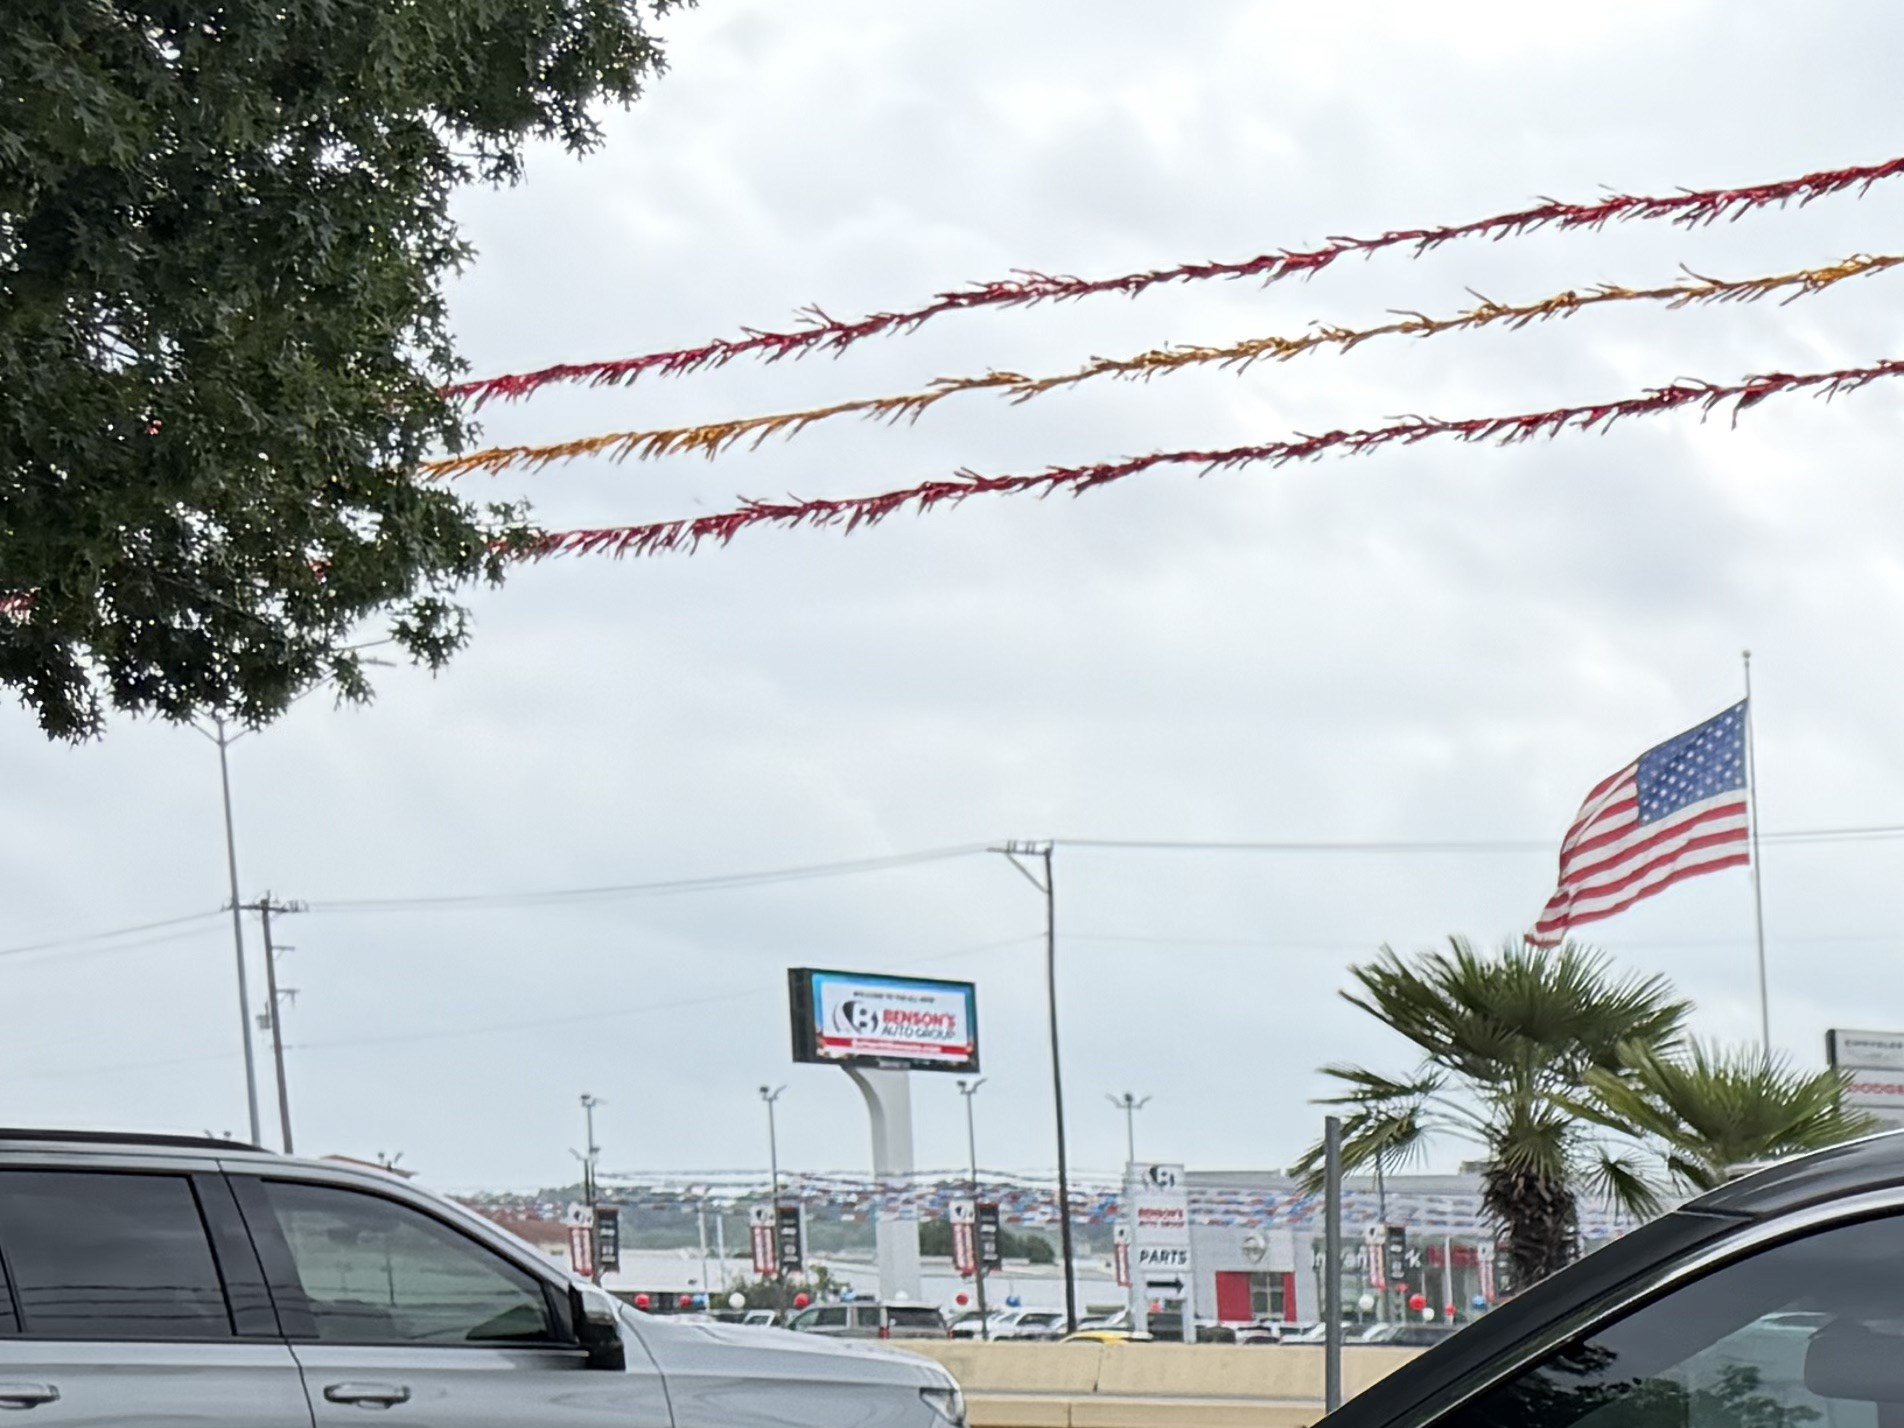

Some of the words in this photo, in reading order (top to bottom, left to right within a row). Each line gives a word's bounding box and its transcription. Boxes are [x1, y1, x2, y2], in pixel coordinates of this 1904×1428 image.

[884, 1009, 956, 1028] BENSON'S
[882, 1025, 913, 1039] AUTO
[1140, 1250, 1188, 1264] PARTS
